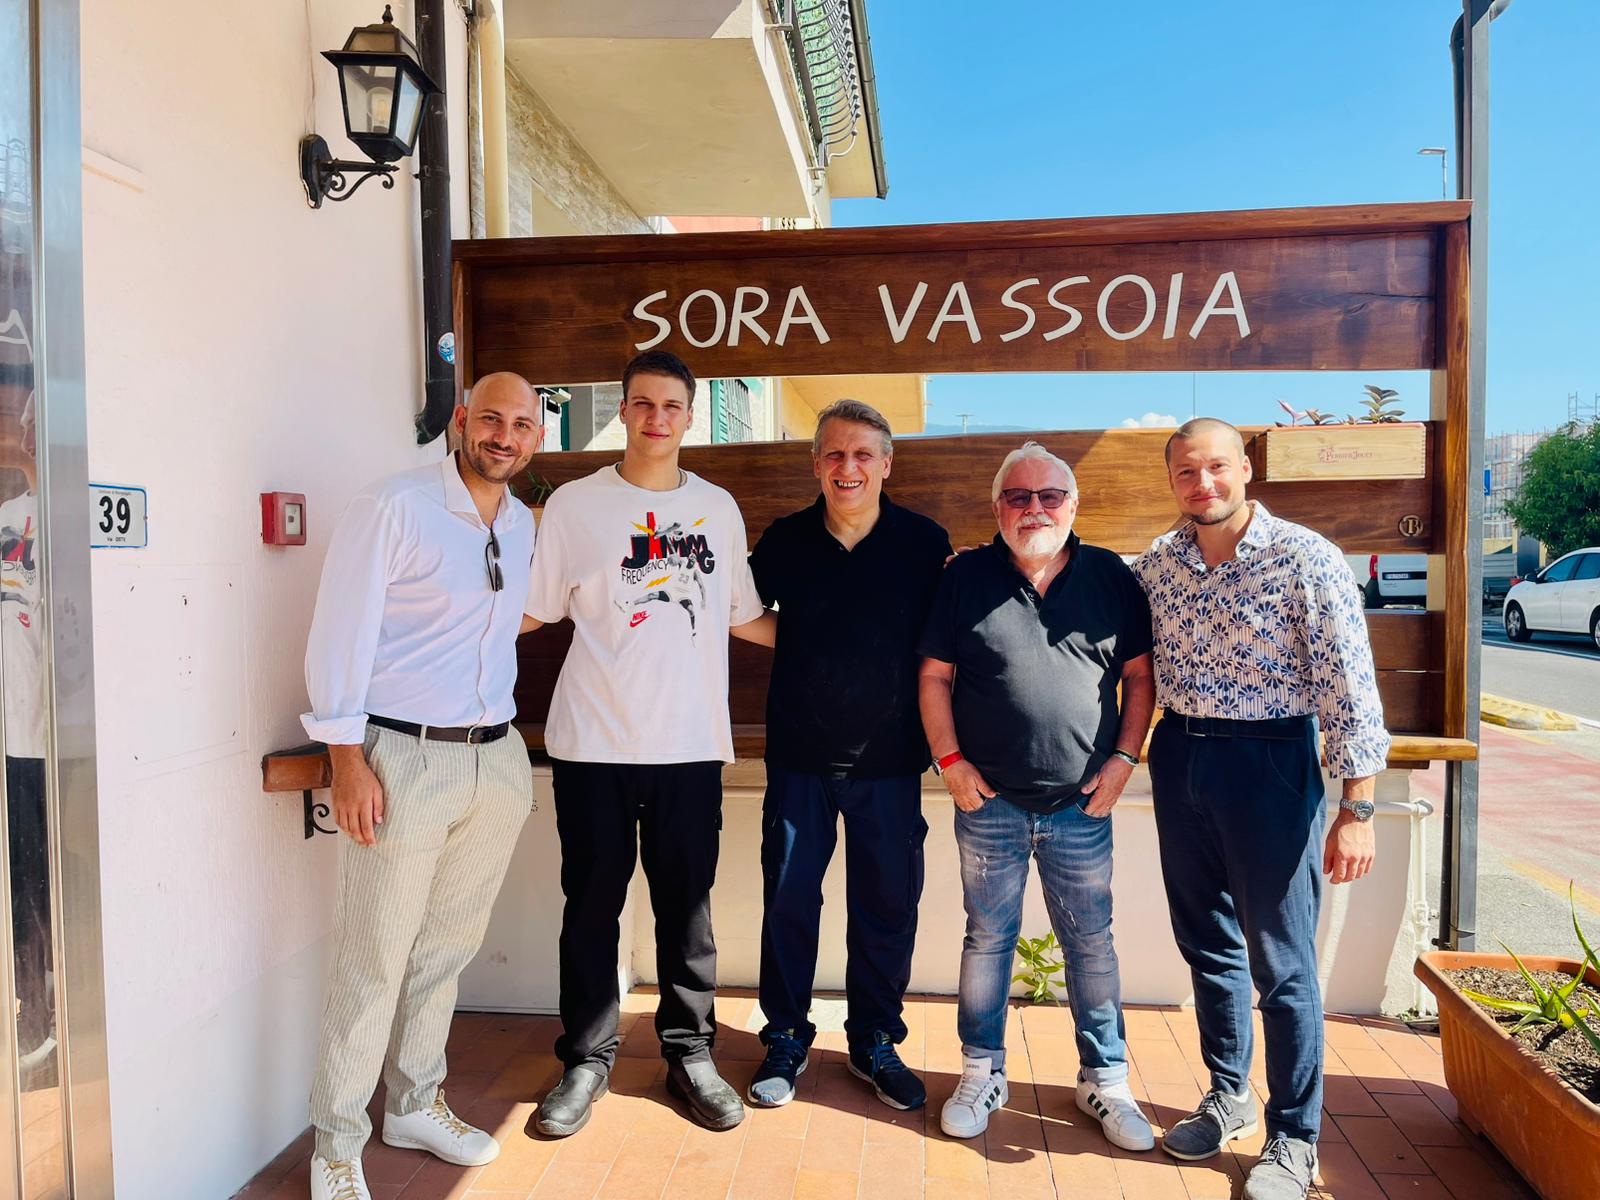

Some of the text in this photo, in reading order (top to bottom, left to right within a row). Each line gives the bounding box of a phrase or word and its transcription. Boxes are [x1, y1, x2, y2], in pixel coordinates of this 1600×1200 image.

[632, 271, 1251, 351] SORA VASSOIA
[98, 495, 131, 534] 39
[621, 559, 669, 585] FREQUENCY
[678, 573, 690, 584] 23
